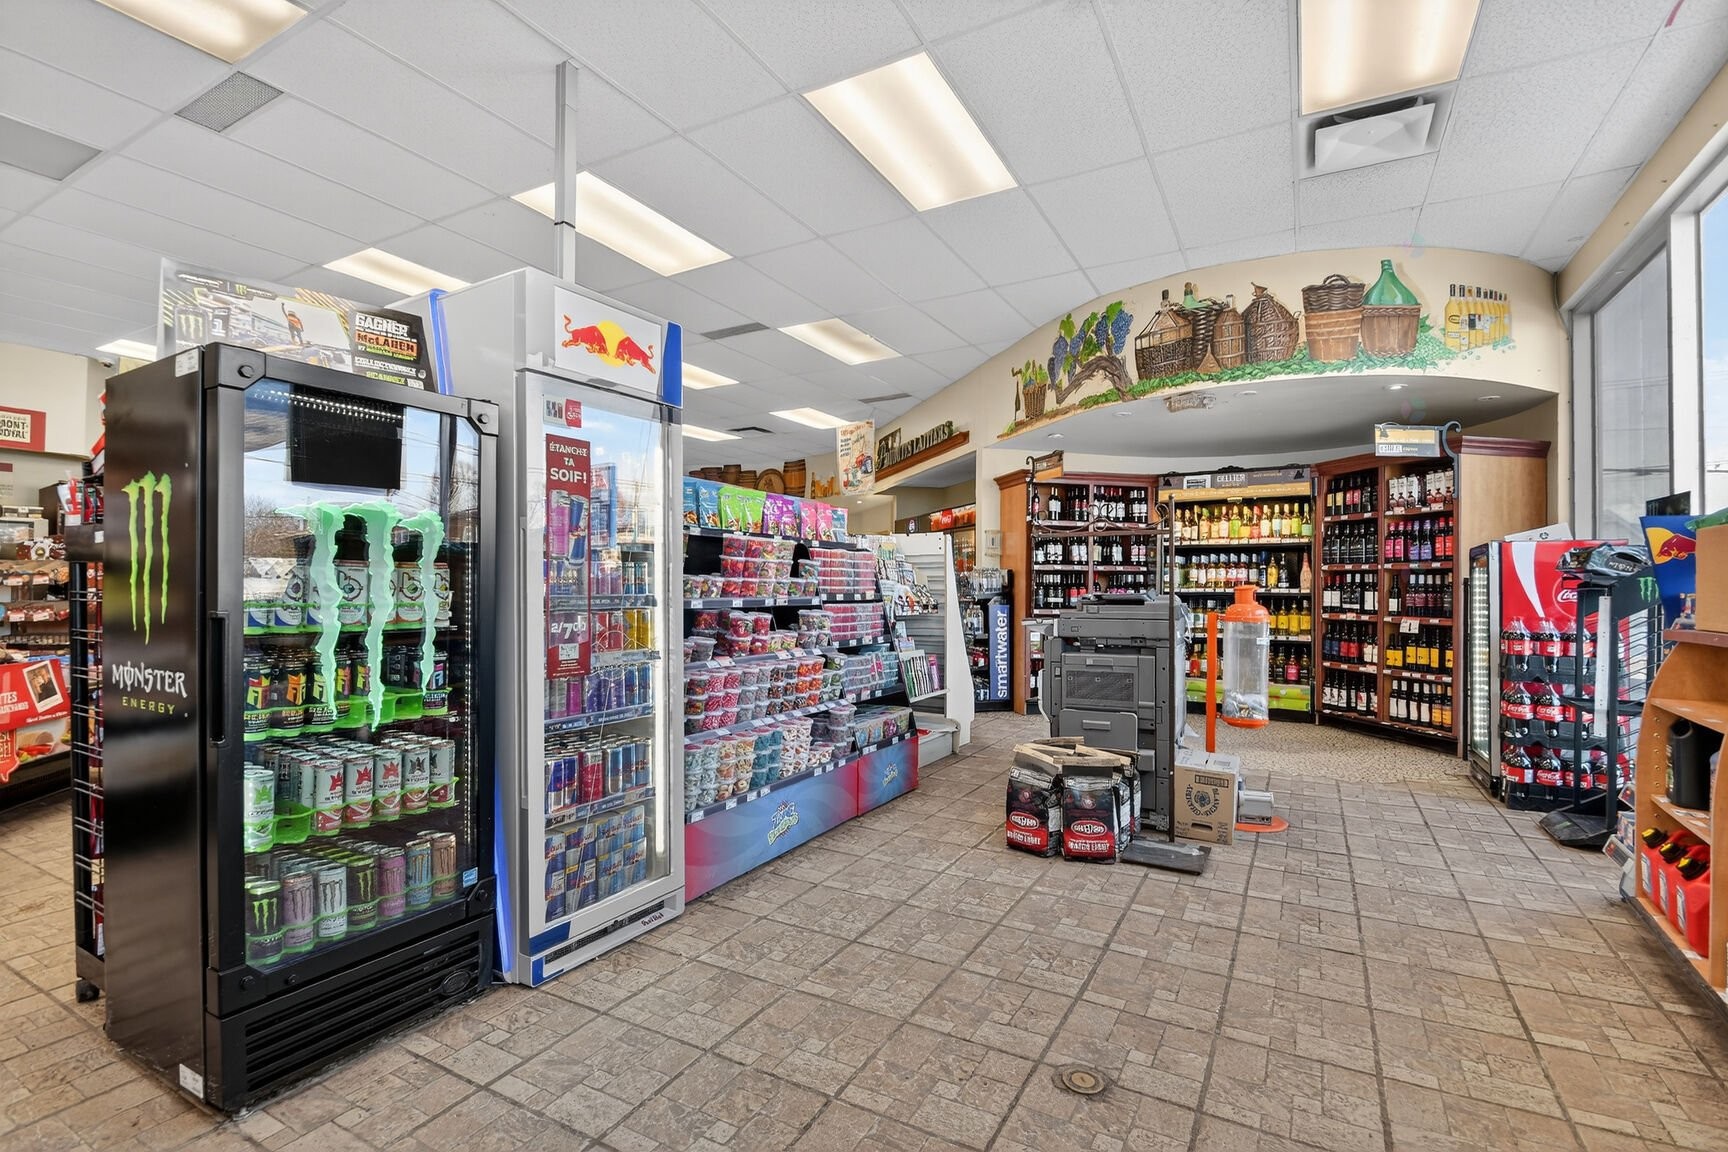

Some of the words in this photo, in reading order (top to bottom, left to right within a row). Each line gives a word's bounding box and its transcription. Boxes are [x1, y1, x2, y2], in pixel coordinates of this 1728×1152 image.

[563, 457, 576, 467] TA
[550, 467, 587, 484] SOIF!
[995, 610, 1008, 698] smartwater
[122, 696, 176, 715] ENERGY
